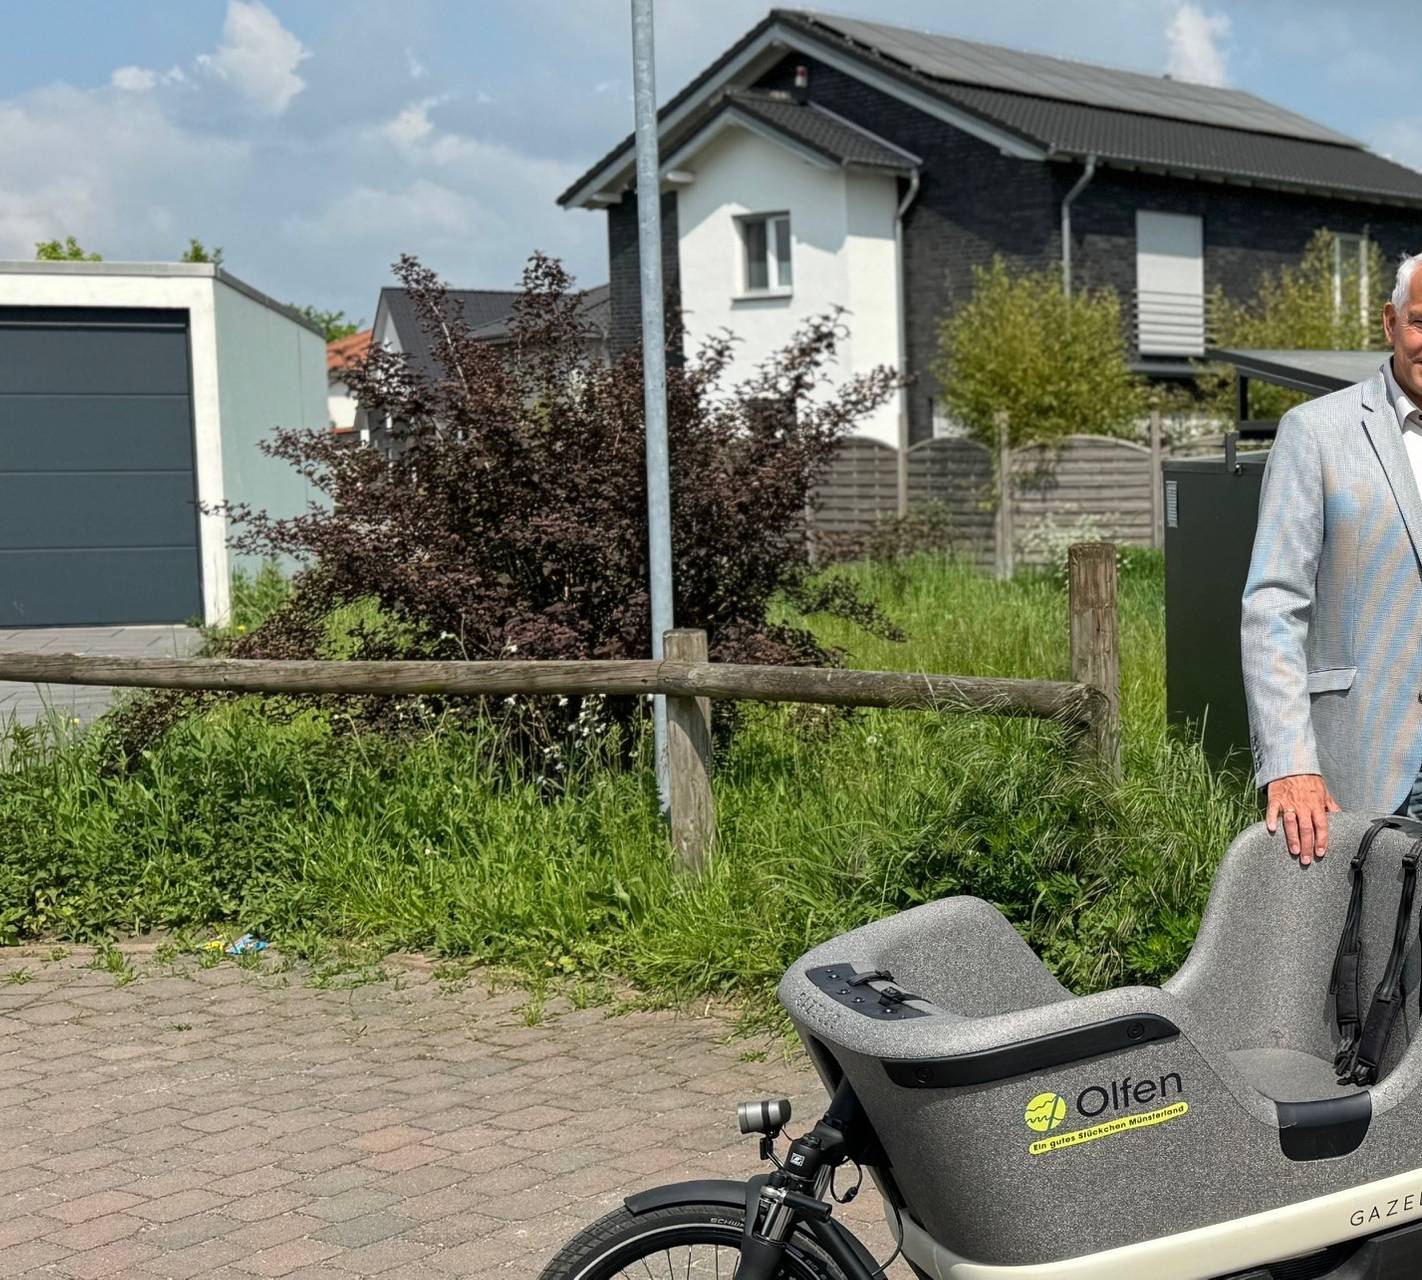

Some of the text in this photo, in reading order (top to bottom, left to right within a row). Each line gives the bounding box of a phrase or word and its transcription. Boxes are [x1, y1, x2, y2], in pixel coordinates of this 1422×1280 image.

[1076, 1072, 1183, 1117] Olfen
[1033, 1105, 1185, 1151] Ein gutes Stückchen Münsterland
